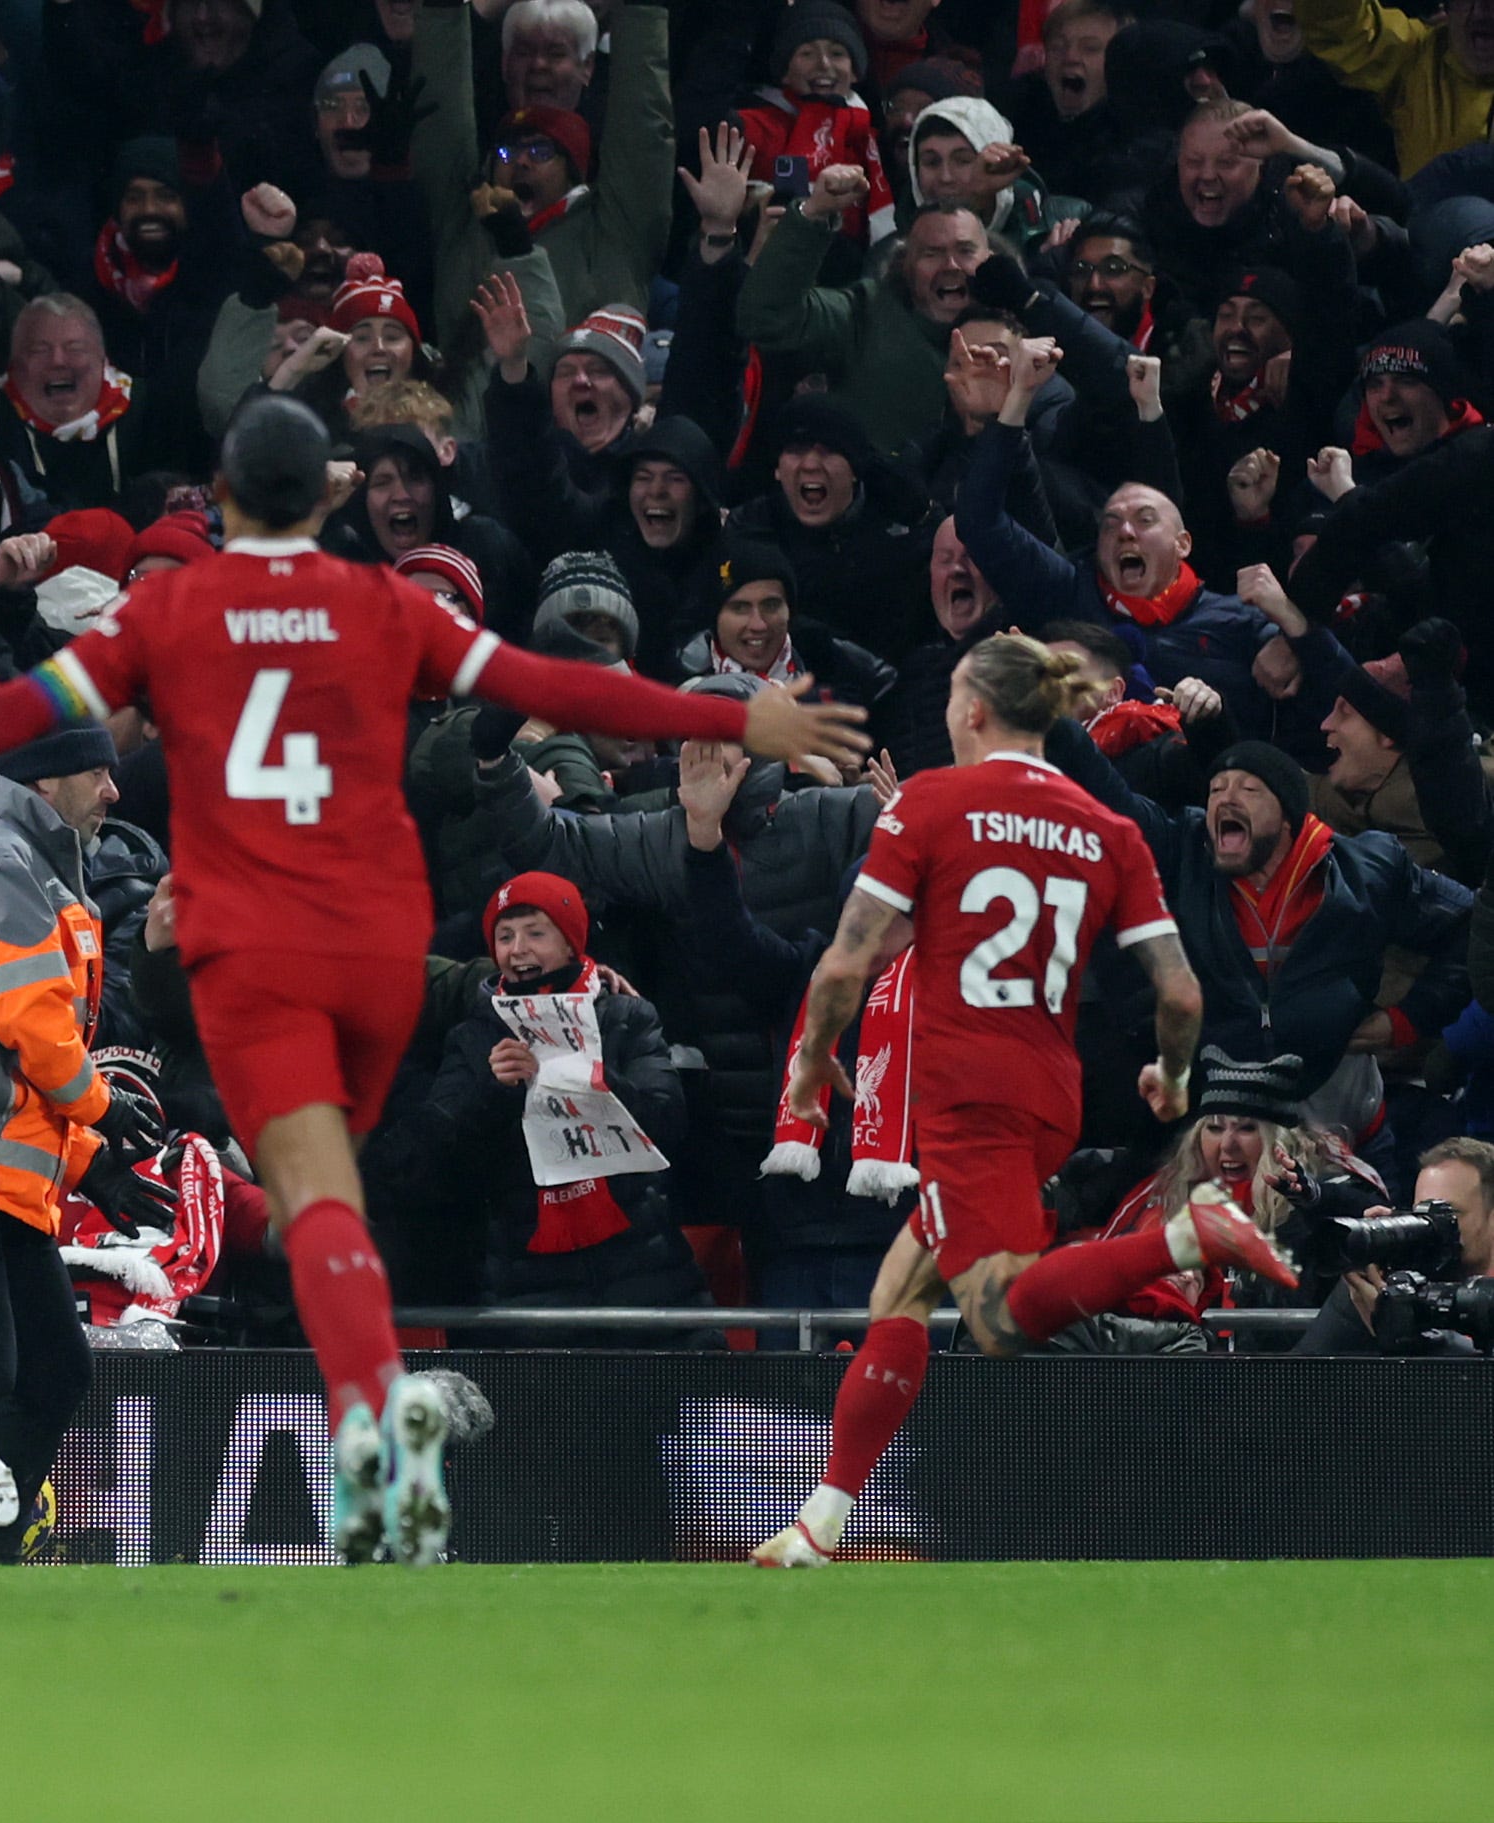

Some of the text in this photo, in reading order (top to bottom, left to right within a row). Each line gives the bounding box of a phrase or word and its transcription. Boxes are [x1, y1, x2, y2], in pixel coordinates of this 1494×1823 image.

[224, 607, 339, 644] VIRGIL
[225, 667, 333, 825] 4
[965, 811, 1103, 863] TSIMIKAS
[959, 866, 1088, 1014] 21
[864, 1363, 912, 1396] LFC
